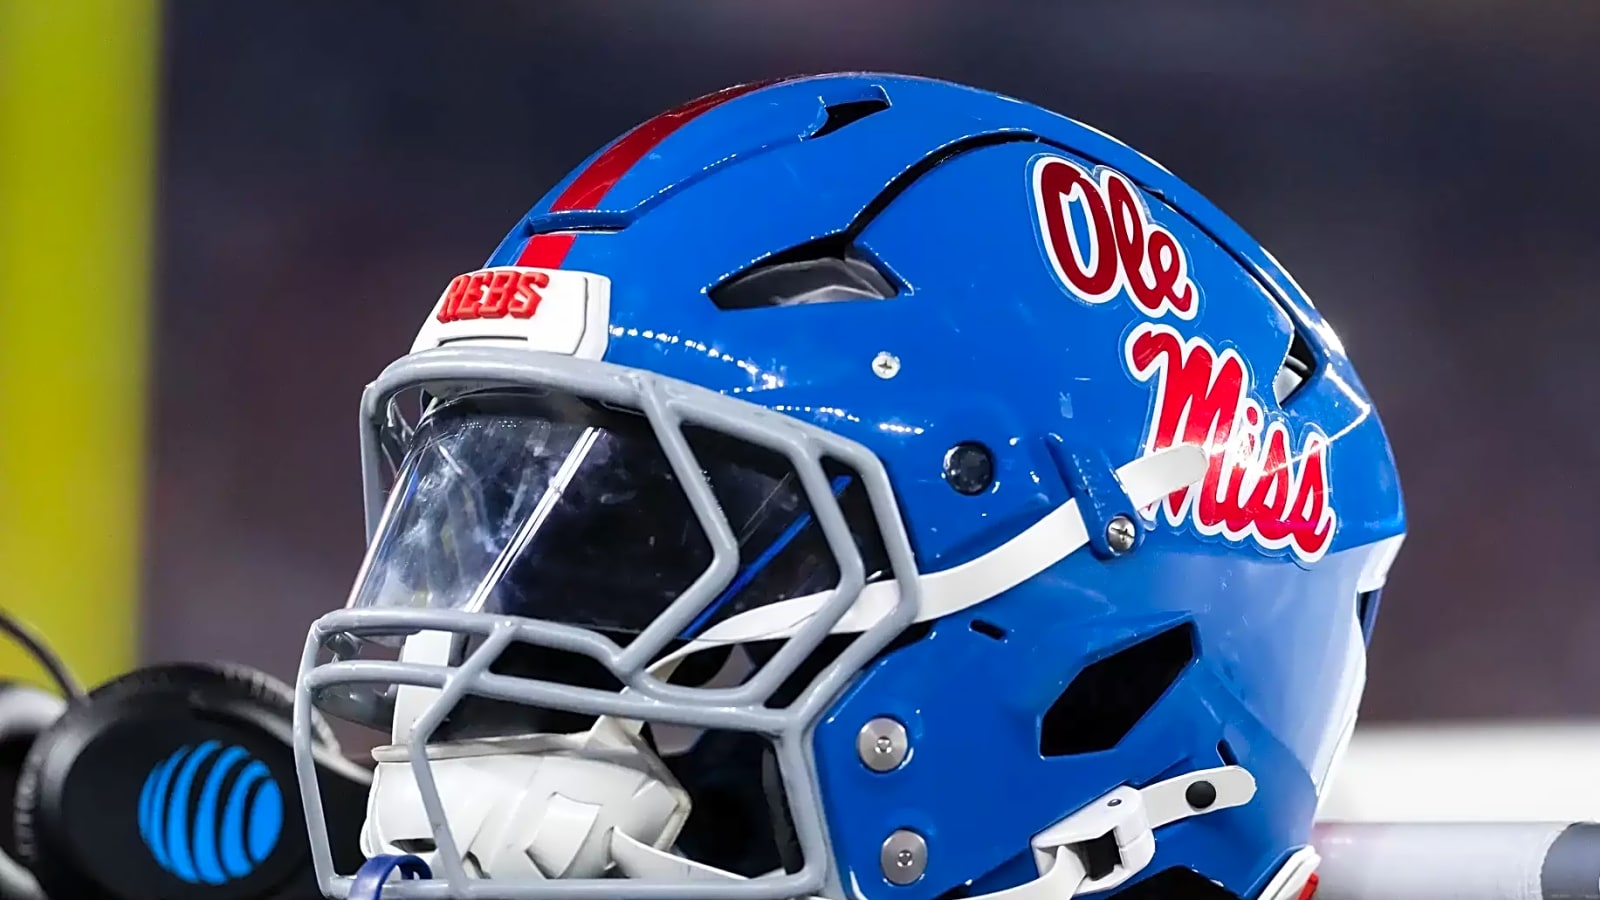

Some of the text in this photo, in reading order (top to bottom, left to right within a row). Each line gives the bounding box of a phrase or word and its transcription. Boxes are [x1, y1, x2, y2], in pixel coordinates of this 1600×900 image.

[436, 270, 550, 324] REBS
[1036, 158, 1196, 317] Ole
[1127, 325, 1335, 560] Miss
